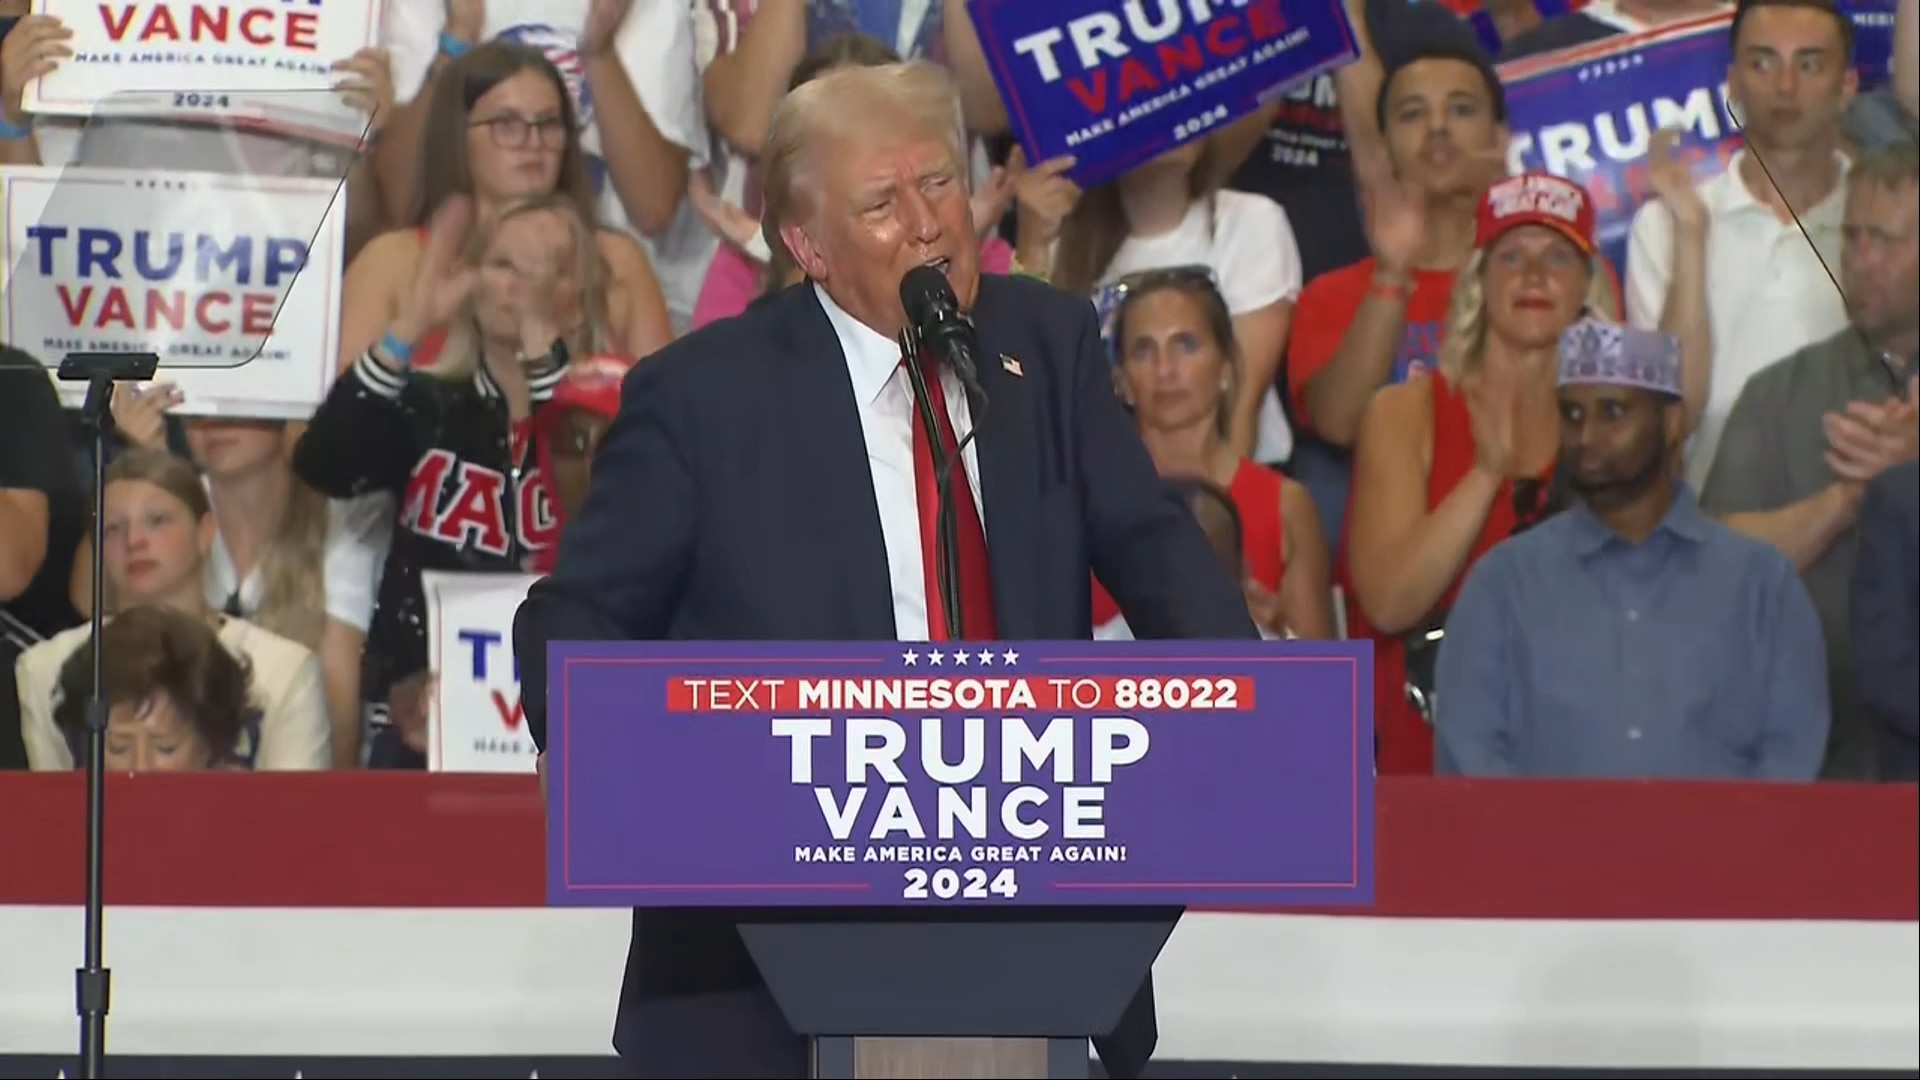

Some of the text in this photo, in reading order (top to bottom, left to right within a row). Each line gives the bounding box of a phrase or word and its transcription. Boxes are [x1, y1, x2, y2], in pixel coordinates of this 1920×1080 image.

[99, 4, 318, 50] VANCE
[75, 53, 121, 64] MAKE
[129, 53, 205, 65] AMERICA
[212, 56, 266, 66] GREAT
[1066, 0, 1287, 114] VANCE
[172, 92, 230, 108] 2024
[1065, 118, 1115, 146] MAKE
[1118, 83, 1192, 127] AMERICA
[1194, 56, 1248, 90] GREAT
[1172, 103, 1229, 141] 2024
[1507, 84, 1743, 178] TRUM
[26, 226, 309, 287] TRUMP
[56, 283, 277, 337] VANCE
[683, 678, 1238, 710] TEXT MINNESOTA TO 88022
[771, 717, 1150, 784] TRUMP
[813, 786, 1106, 840] VANCE
[795, 846, 1126, 862] MAKE AMERICA GREAT AGAIN!
[903, 868, 1018, 899] 2024
